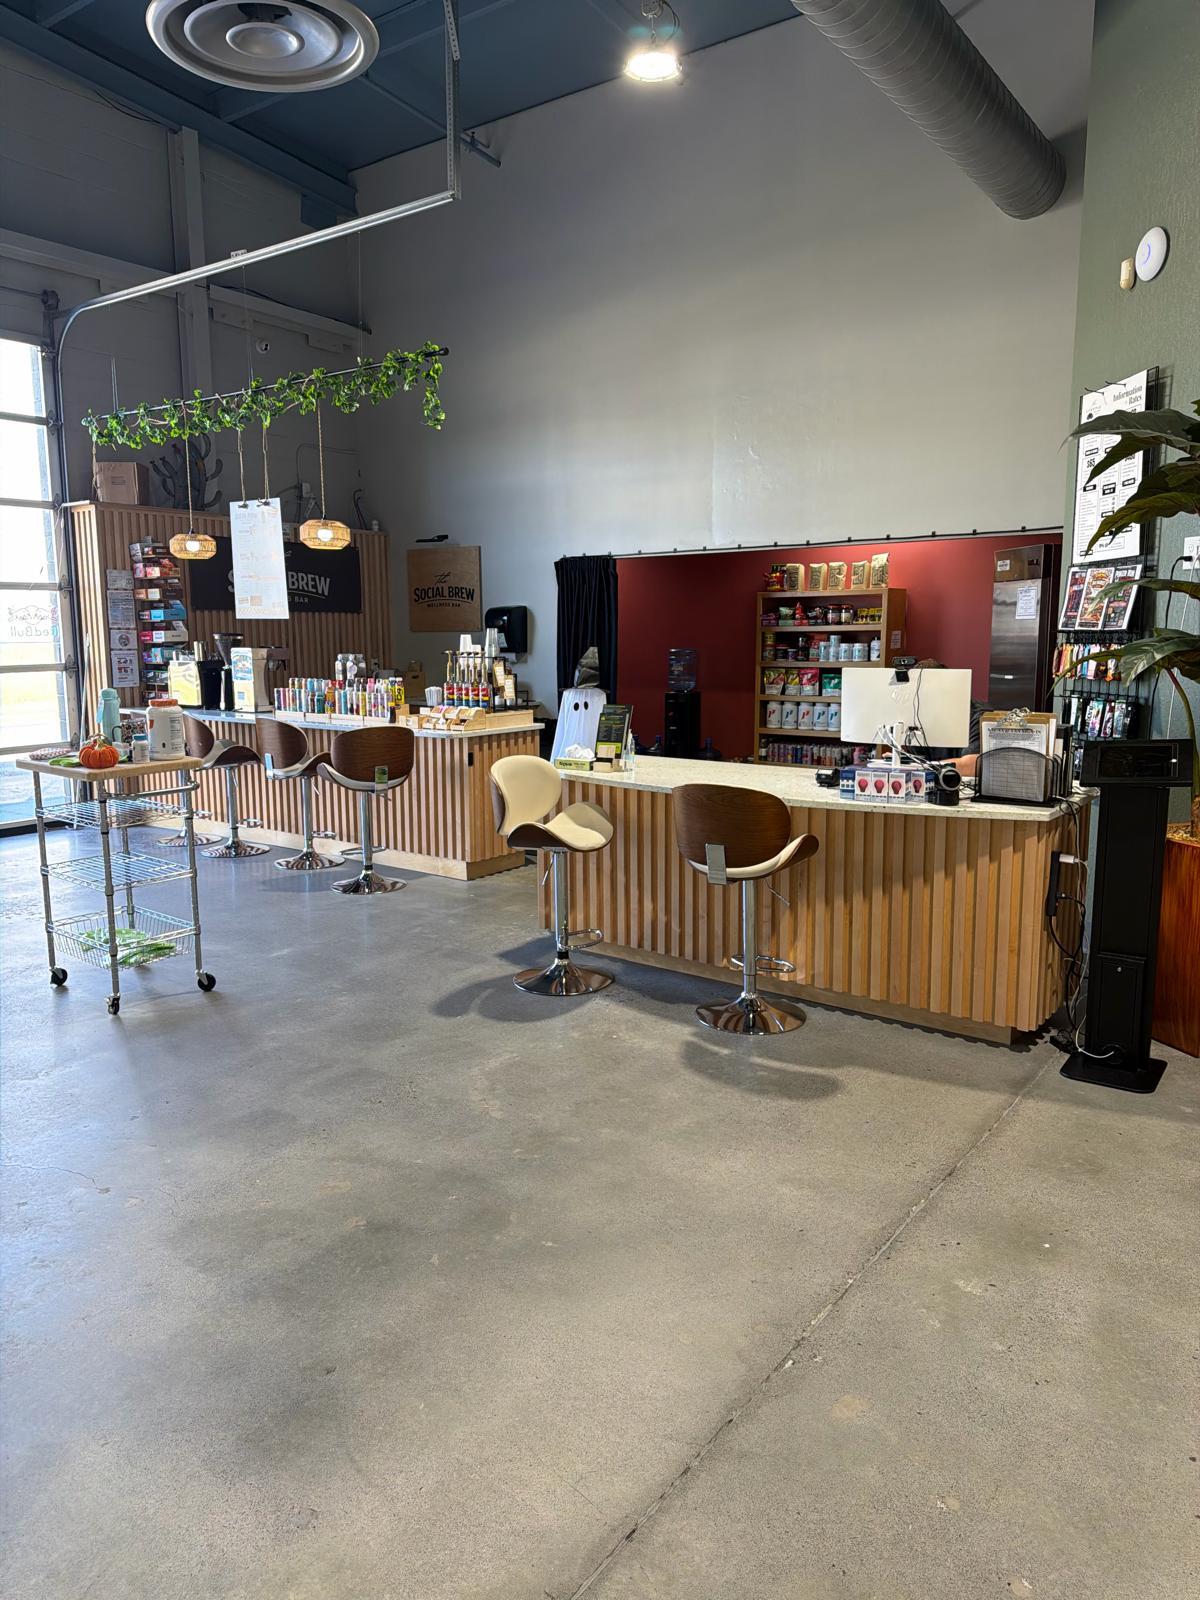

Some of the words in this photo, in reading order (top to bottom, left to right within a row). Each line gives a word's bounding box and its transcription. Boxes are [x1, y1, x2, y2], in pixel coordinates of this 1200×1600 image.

[1113, 385, 1142, 403] Information
[287, 571, 331, 595] BREW
[414, 586, 448, 602] SOCIAL
[448, 586, 475, 602] BREW
